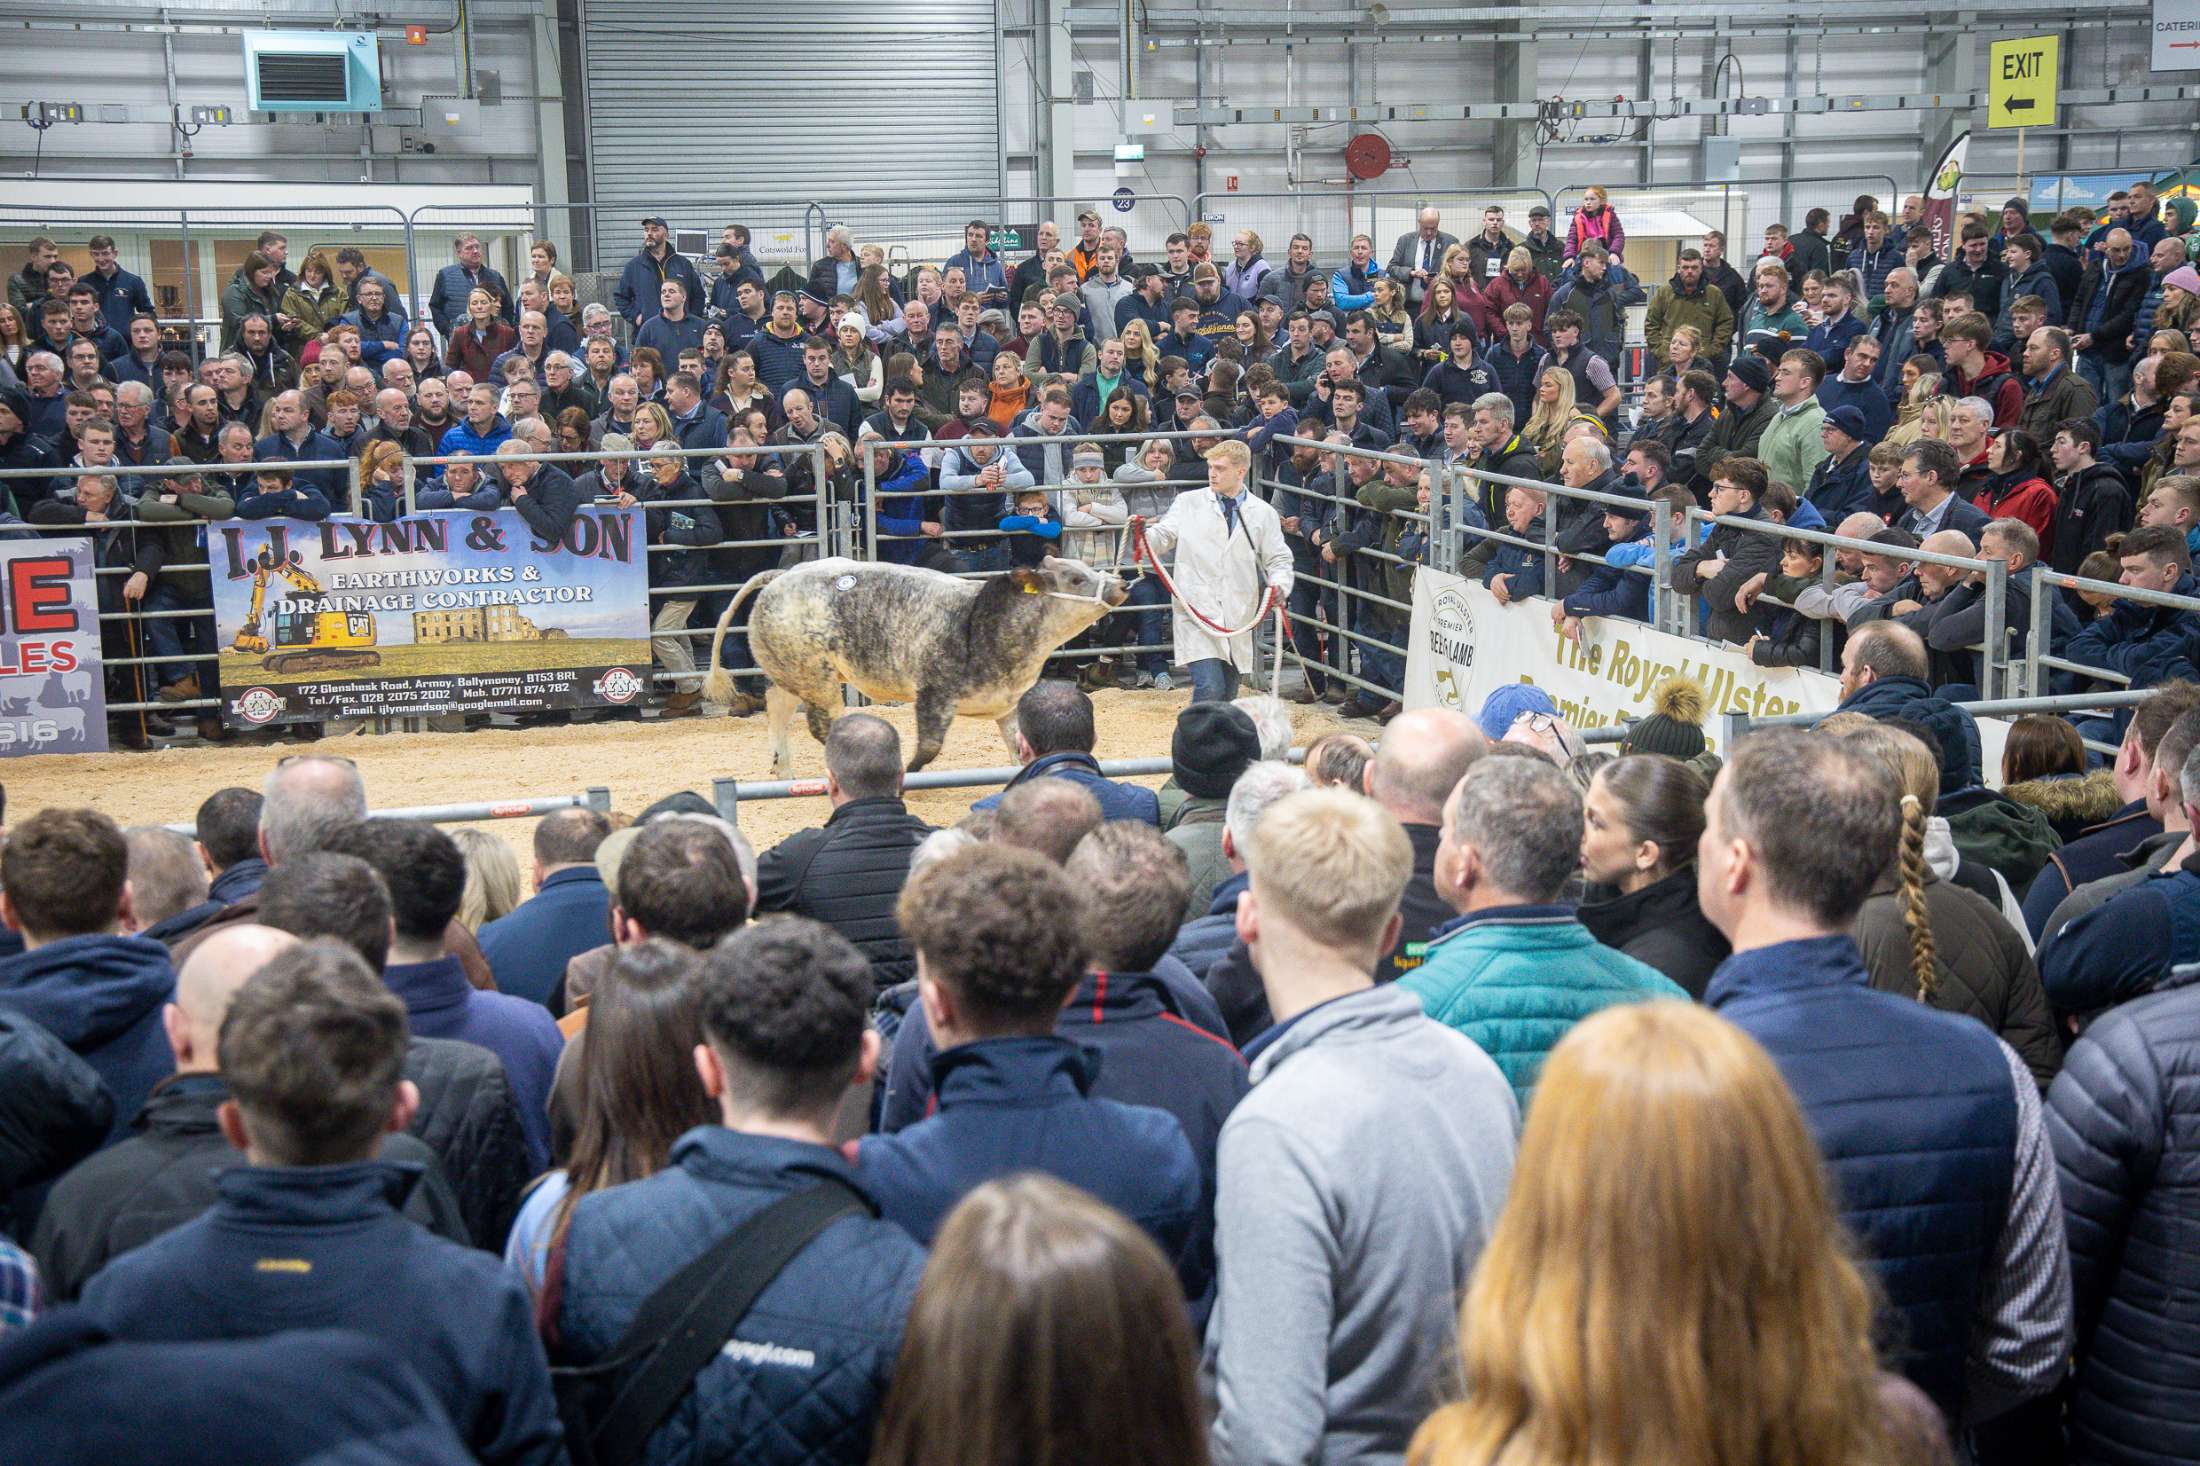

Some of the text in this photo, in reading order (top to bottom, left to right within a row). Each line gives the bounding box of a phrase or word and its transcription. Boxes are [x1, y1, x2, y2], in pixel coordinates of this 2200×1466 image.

[2003, 52, 2043, 80] EXIT
[1117, 199, 1130, 209] 23
[759, 246, 793, 254] Cotswold
[221, 526, 303, 581] I.J.
[317, 519, 448, 561] LYNN
[465, 516, 509, 553] &
[331, 565, 541, 589] EARTHWORKS &
[0, 556, 79, 634] E
[278, 586, 593, 616] DRAINAGE CONTRACTOR
[349, 617, 369, 634] CAT
[1456, 602, 1473, 634] ULSTER
[298, 686, 318, 695] 172
[320, 682, 379, 694] Glenshesk
[458, 676, 524, 687] Ballymoney,
[527, 672, 555, 683] BT53
[557, 671, 578, 681] 8RL
[308, 683, 569, 705] Tel./Fax. 028 2075 2002 Mob. 07711 874 782
[593, 678, 643, 695] LYNN
[231, 697, 287, 715] LYNN
[343, 706, 376, 716] Email.
